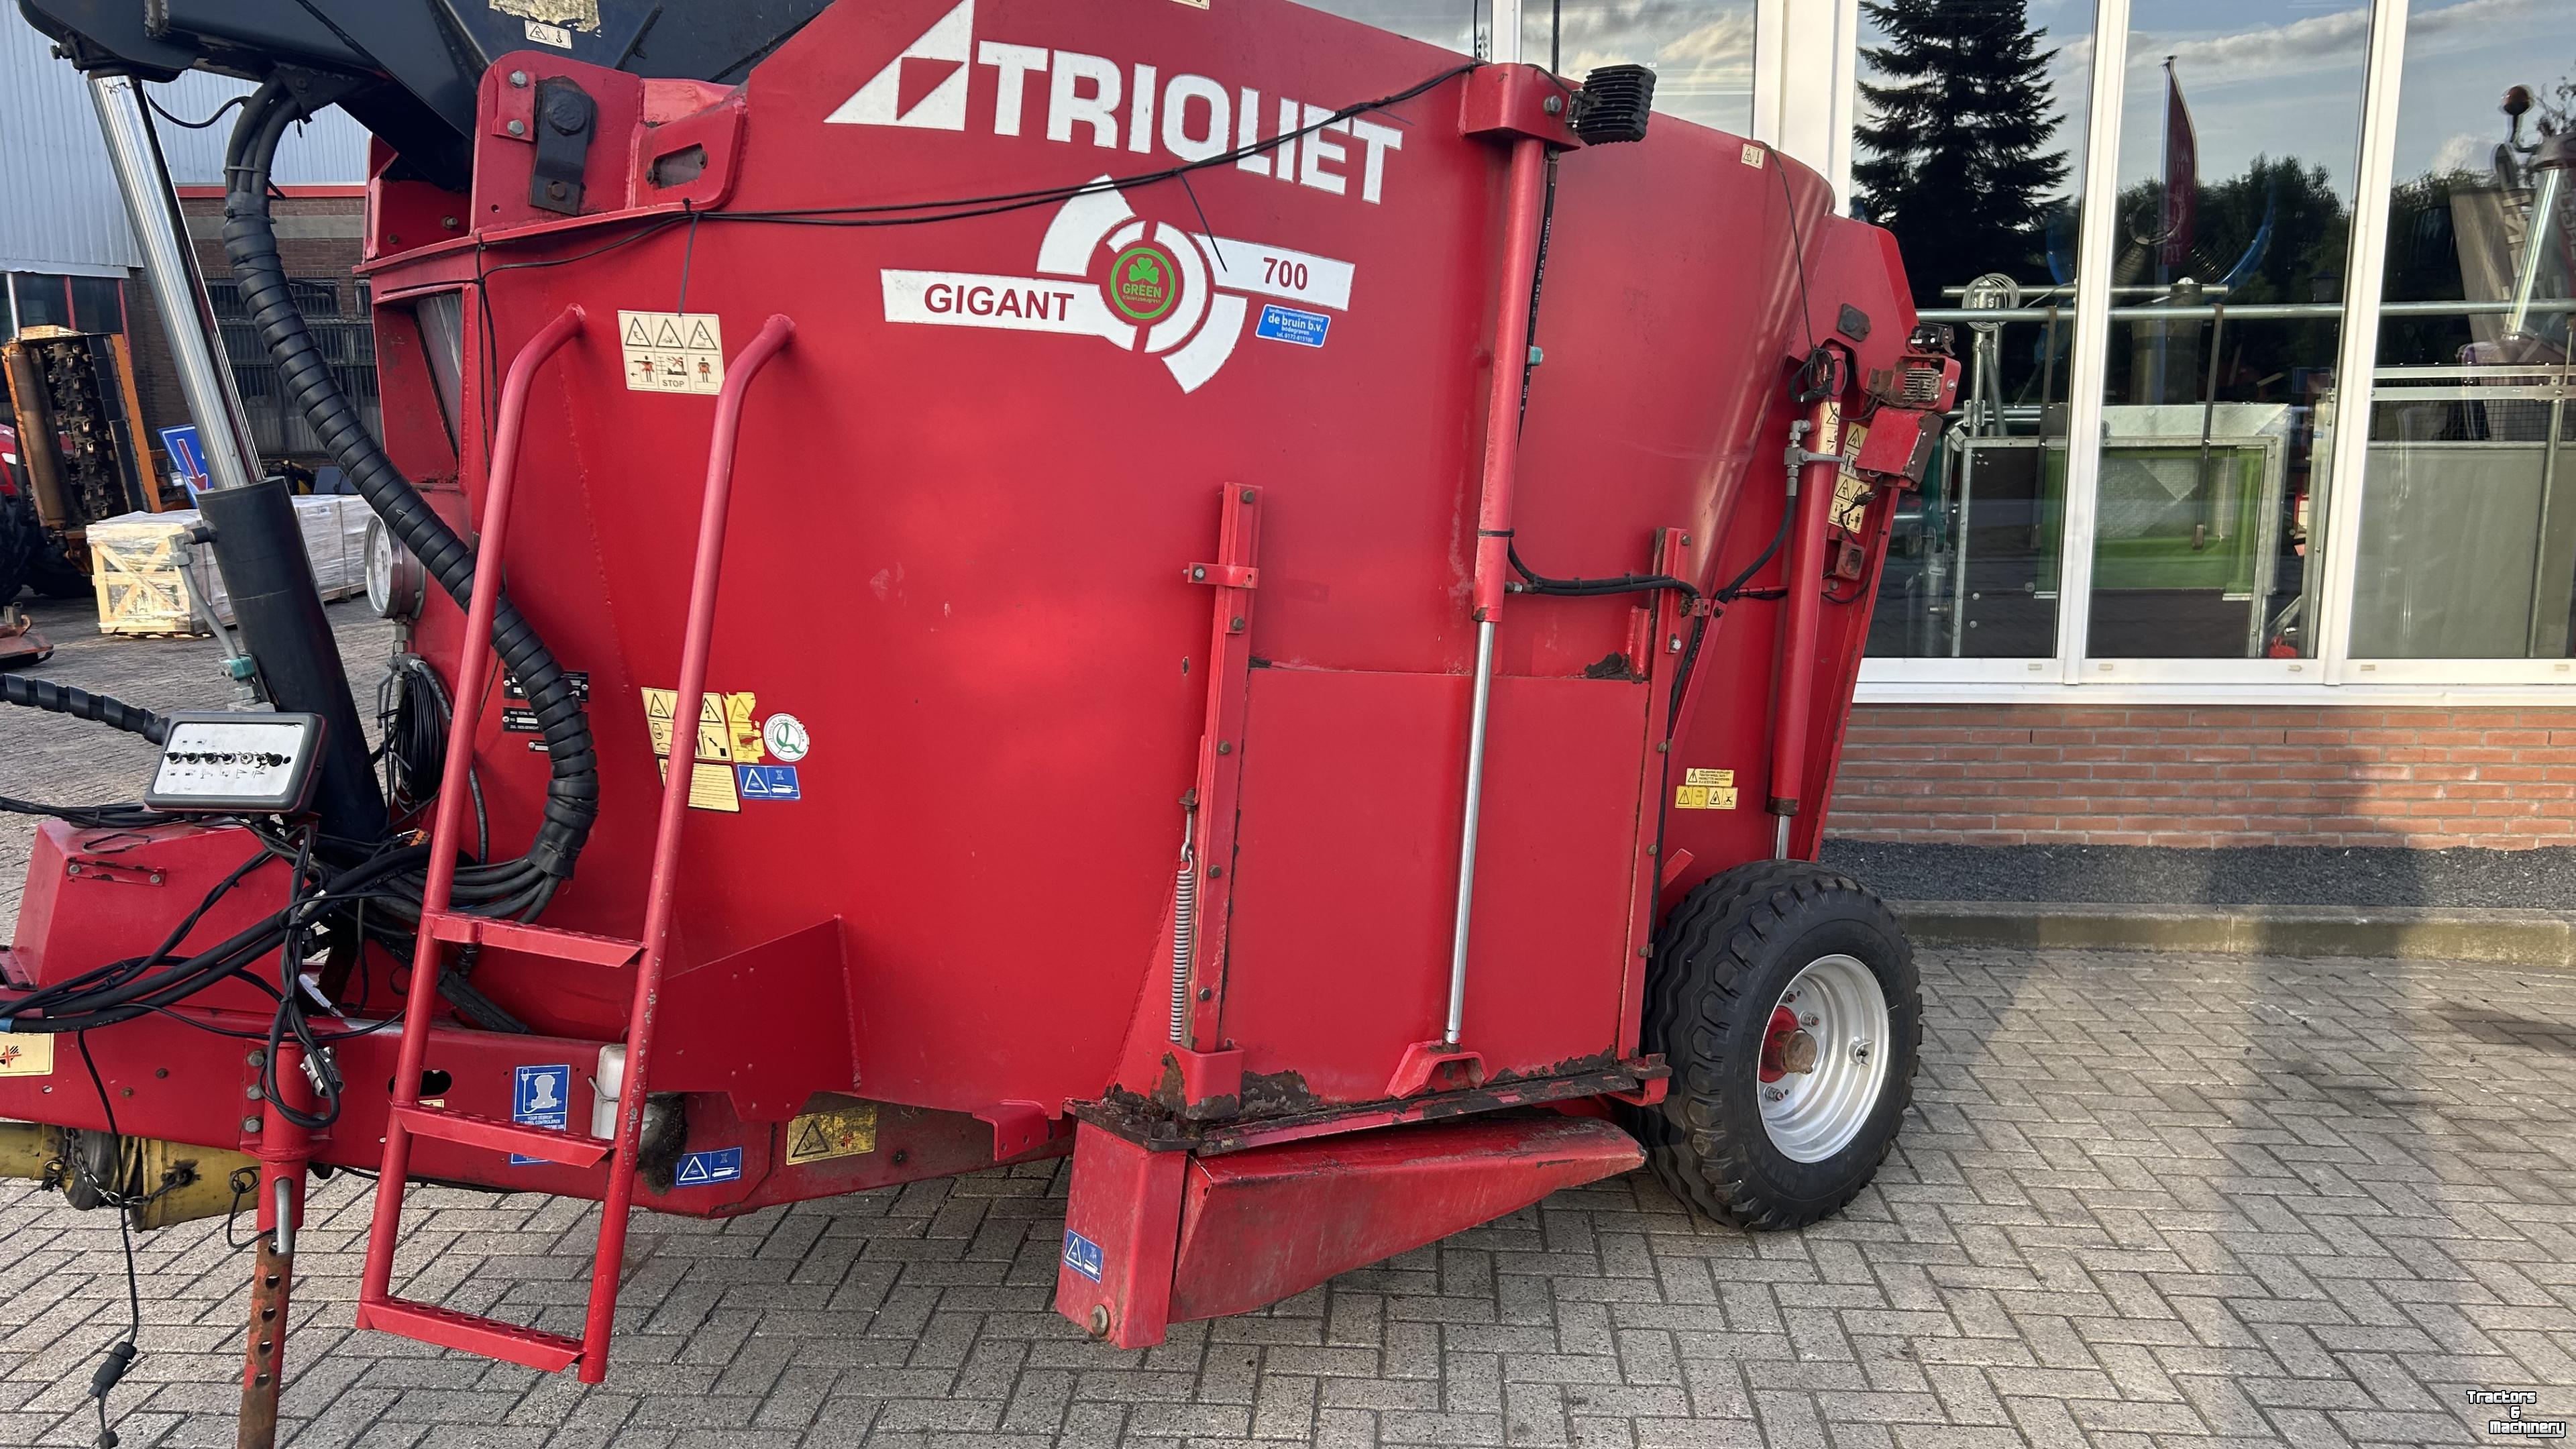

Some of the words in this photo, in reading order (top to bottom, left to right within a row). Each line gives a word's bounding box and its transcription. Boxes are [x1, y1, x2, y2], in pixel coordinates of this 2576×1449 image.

[977, 40, 1403, 205] TRIOLIET
[1263, 257, 1307, 290] 700
[924, 283, 1075, 321] GIGANT
[1122, 282, 1162, 298] GREEN
[1268, 313, 1280, 324] de
[1282, 315, 1306, 329] bruin
[1307, 320, 1324, 333] b.v.
[662, 380, 684, 388] STOP
